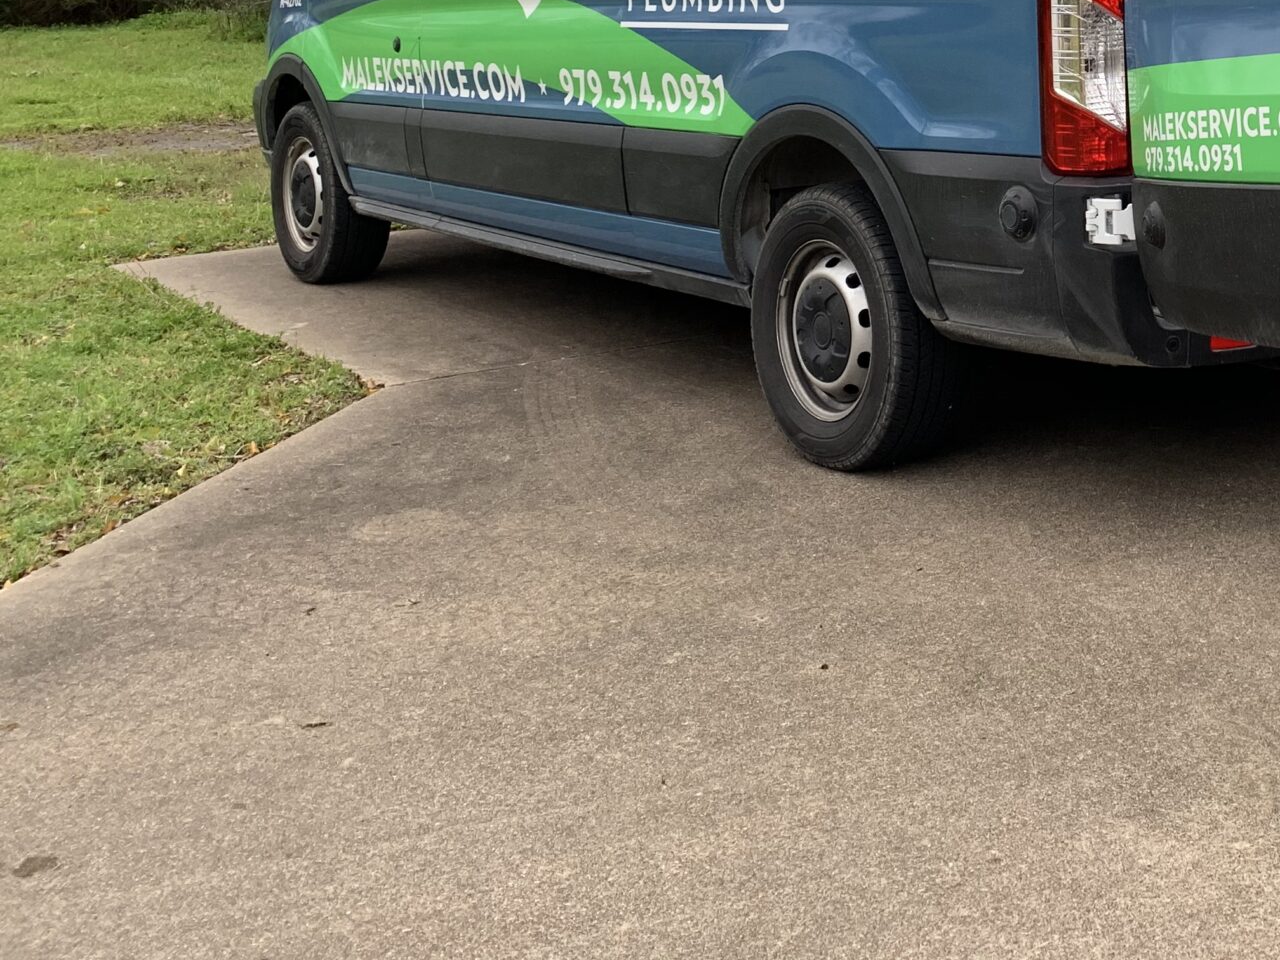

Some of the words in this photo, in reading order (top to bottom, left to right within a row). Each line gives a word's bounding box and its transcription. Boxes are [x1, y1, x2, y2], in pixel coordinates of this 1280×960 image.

[340, 55, 526, 103] MALEKSERVICE.COM
[558, 67, 725, 117] 979.314.0931
[1145, 143, 1243, 172] 979.314.0931
